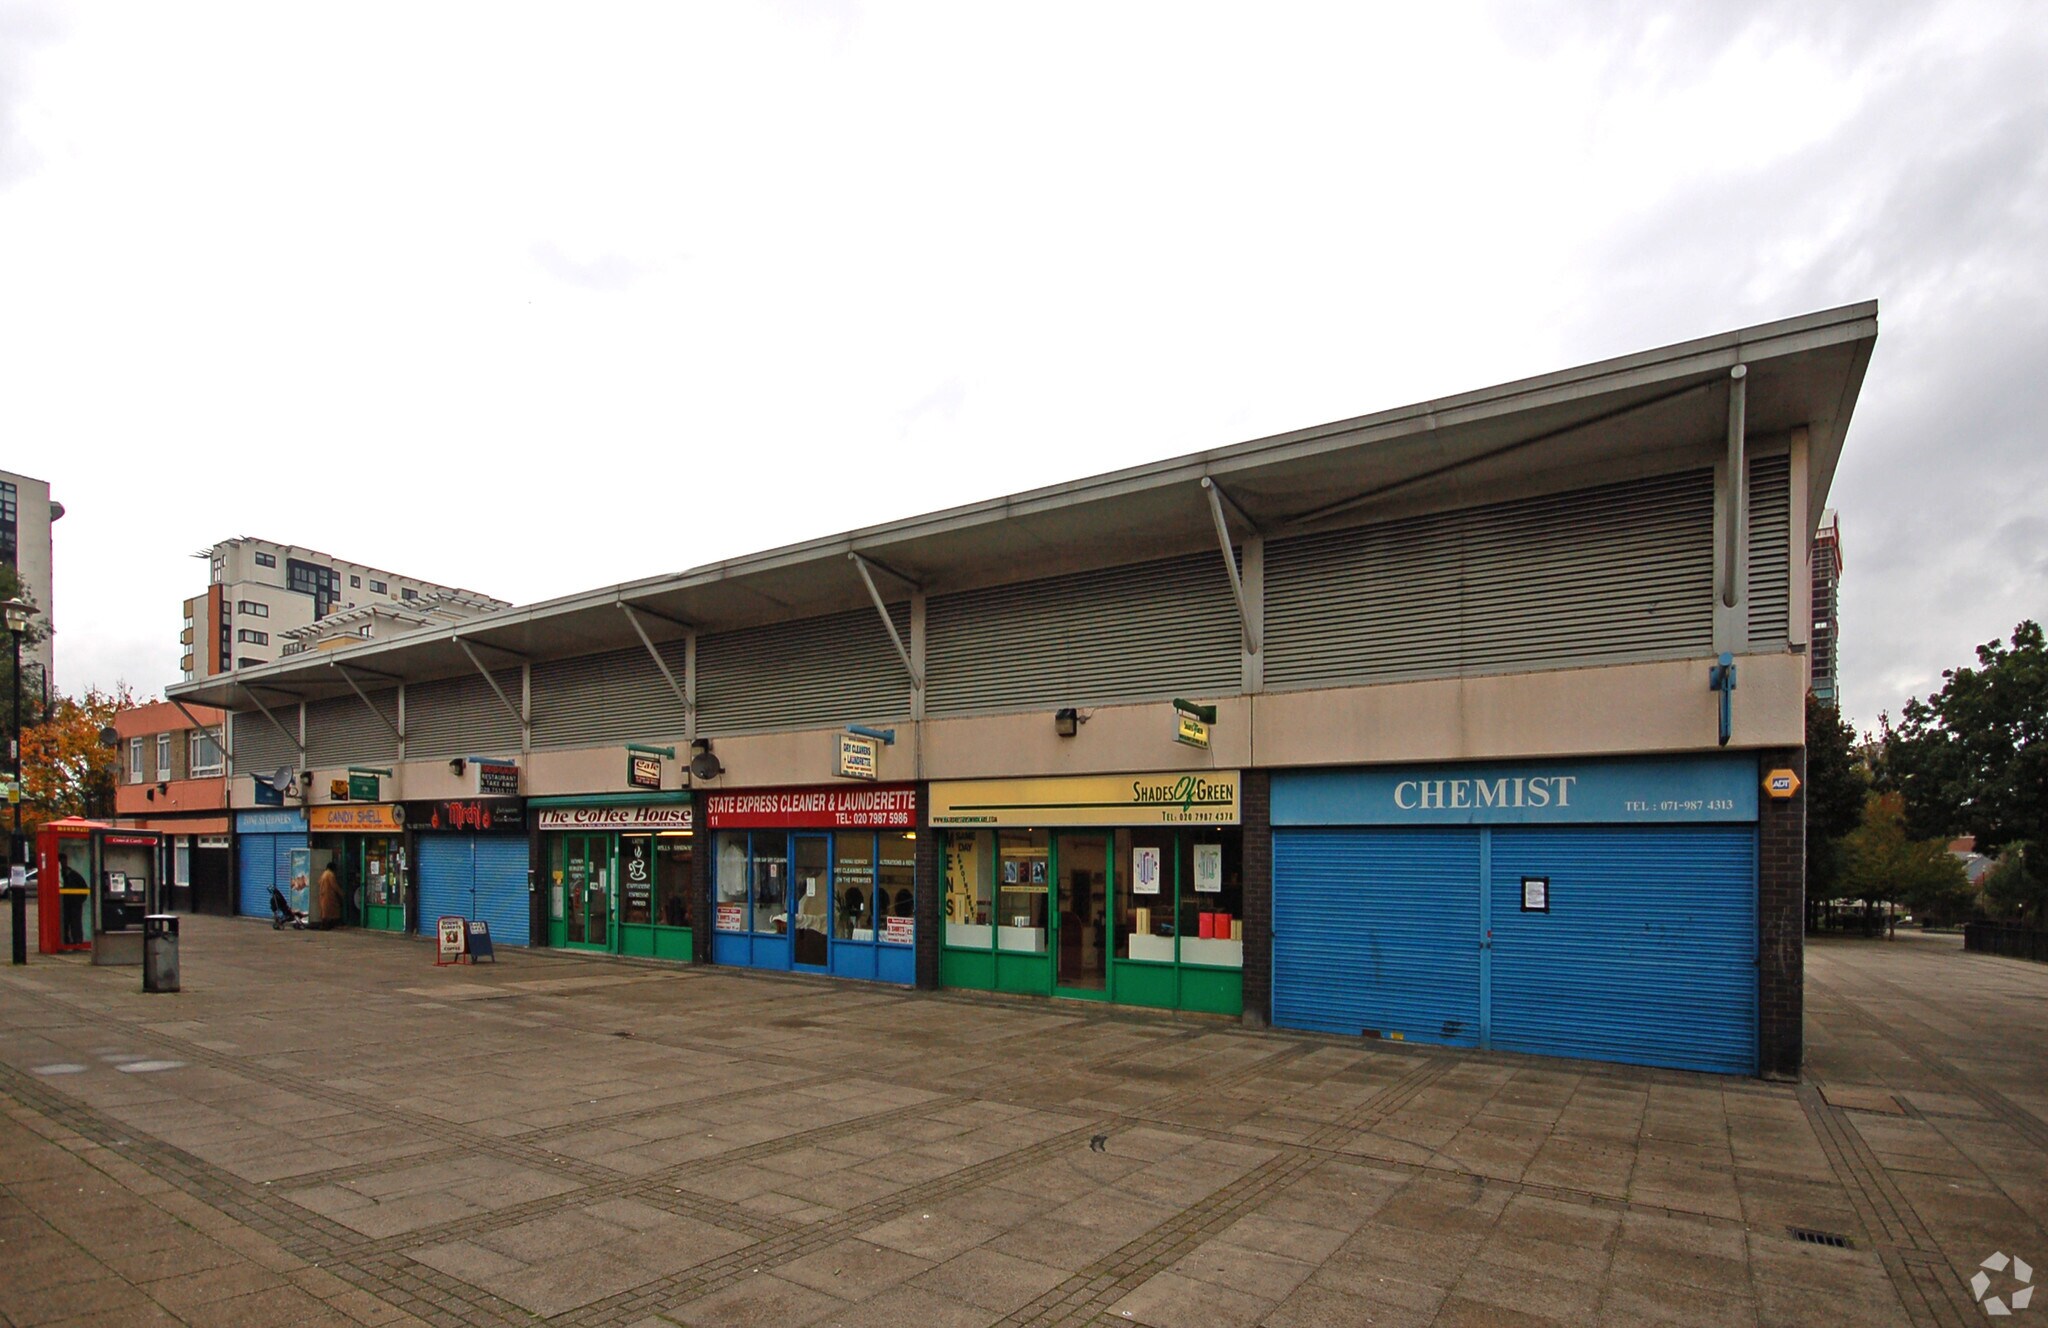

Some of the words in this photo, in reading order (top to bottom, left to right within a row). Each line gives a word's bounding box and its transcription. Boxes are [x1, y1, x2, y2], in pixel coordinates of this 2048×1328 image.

[852, 744, 871, 756] CLEANERS
[1394, 776, 1576, 810] CHEMIST
[708, 797, 735, 813] STATE
[736, 795, 778, 813] EXPRESS
[780, 793, 826, 812] CLEANER
[828, 793, 836, 811] &
[838, 790, 916, 810] LAUNDERETTE
[1707, 800, 1733, 810] 4313
[328, 810, 354, 823] CANDY
[541, 810, 569, 823] The
[574, 808, 629, 823] Coffee
[634, 807, 692, 822] House
[711, 815, 718, 826] 11
[836, 813, 851, 824] TEL:
[853, 812, 867, 824] 020
[869, 812, 887, 824] 7987
[889, 812, 908, 824] 5986
[1180, 813, 1192, 821] 020
